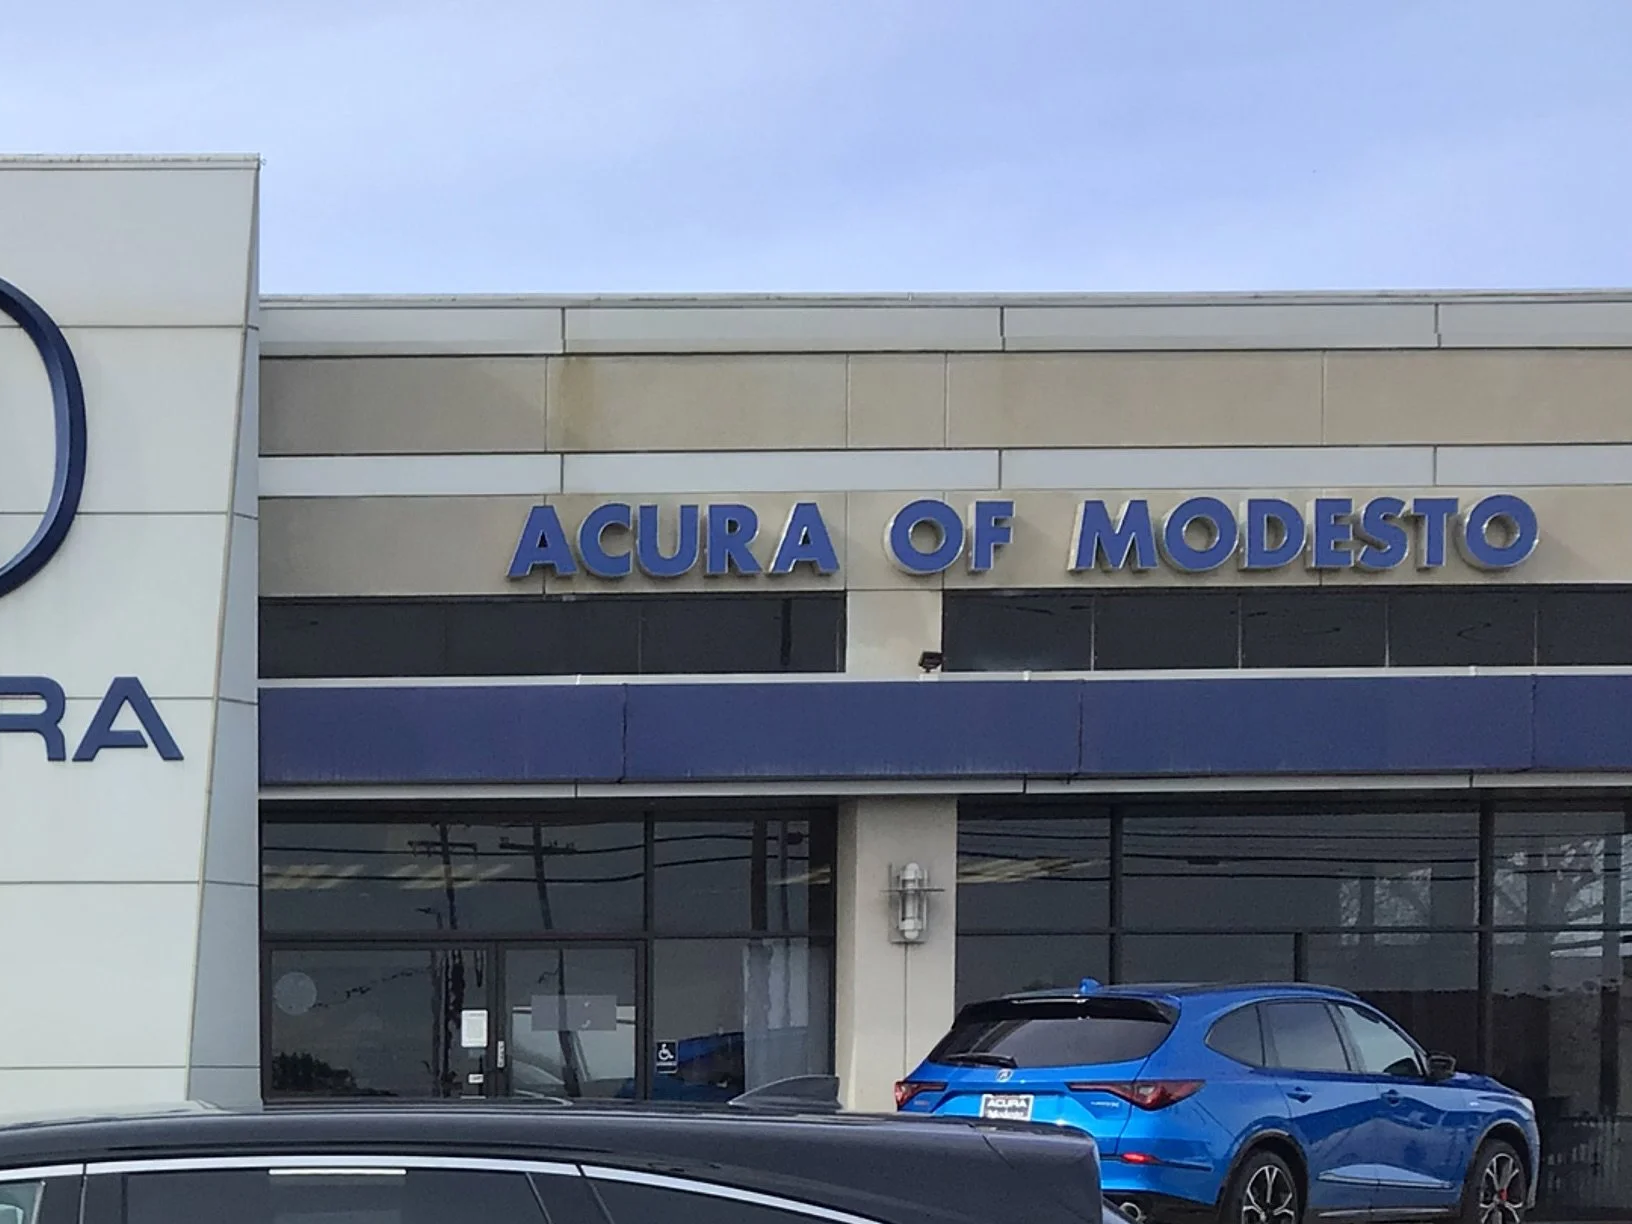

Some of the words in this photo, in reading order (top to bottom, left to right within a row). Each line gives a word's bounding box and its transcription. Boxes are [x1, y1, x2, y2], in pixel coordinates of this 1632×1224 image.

[507, 500, 841, 578] ACURA
[886, 497, 1014, 576] OF
[1069, 494, 1541, 572] MODESTO
[987, 1099, 1028, 1108] ACURA
